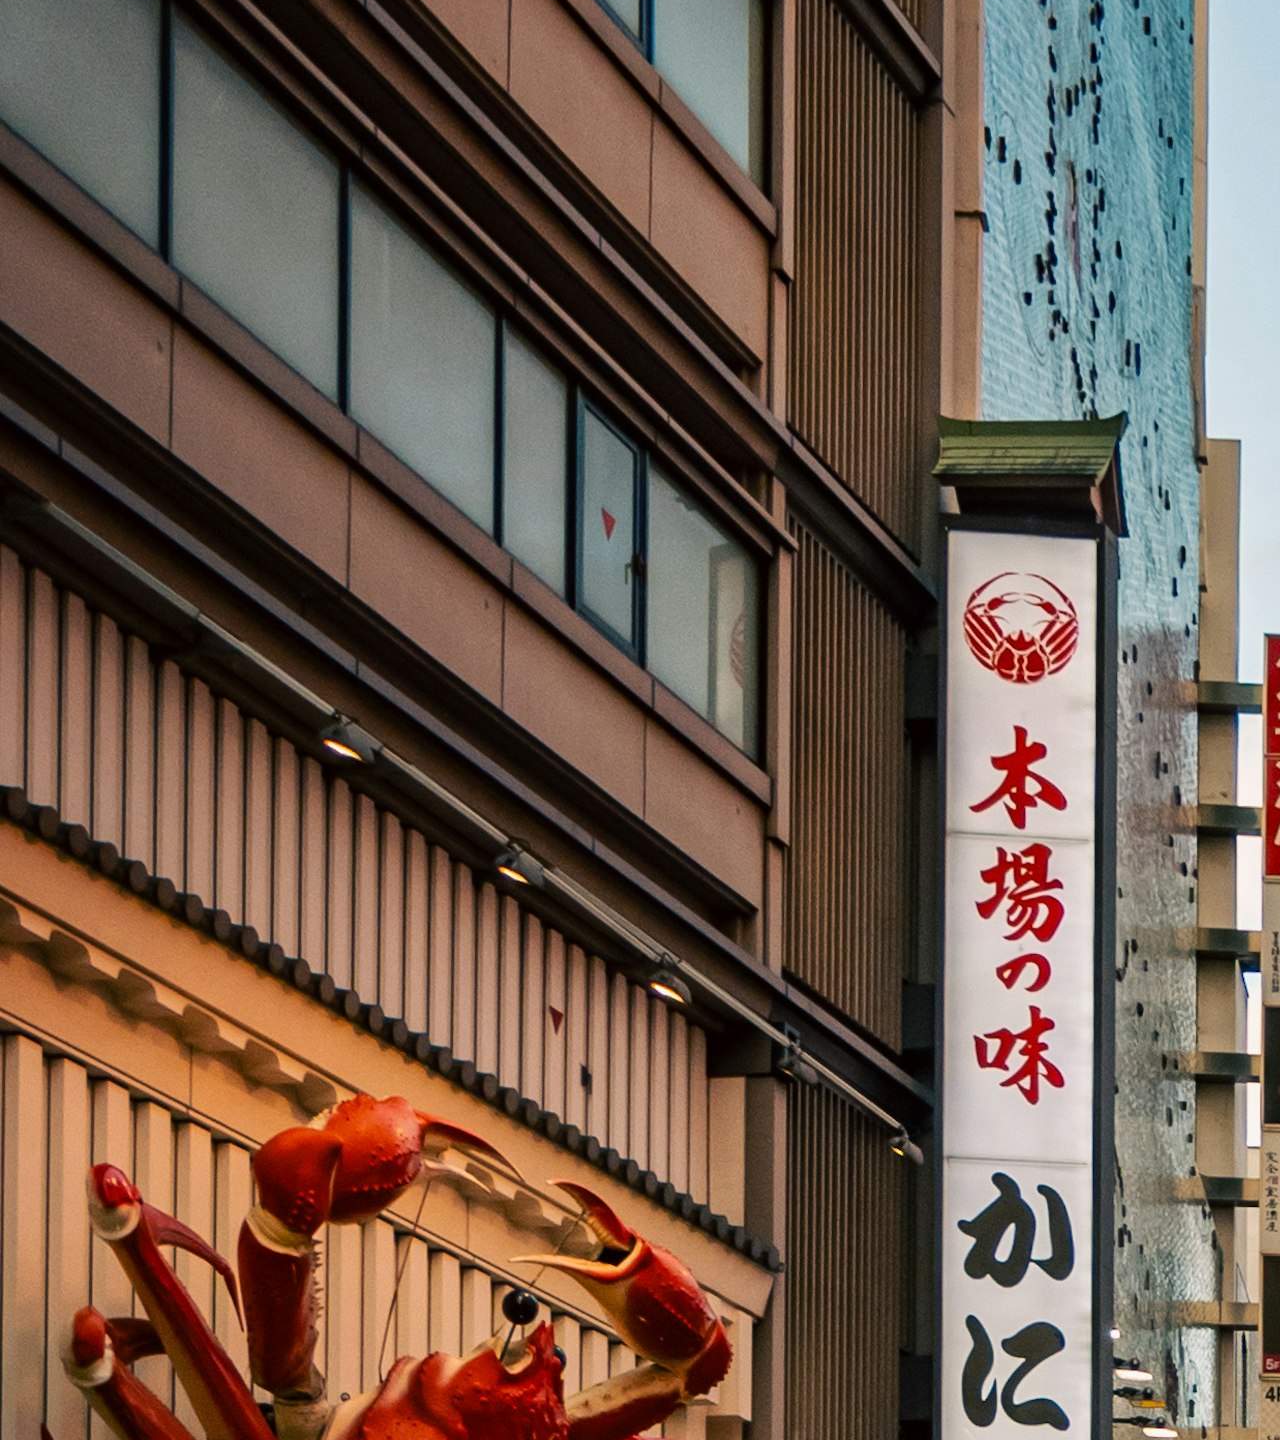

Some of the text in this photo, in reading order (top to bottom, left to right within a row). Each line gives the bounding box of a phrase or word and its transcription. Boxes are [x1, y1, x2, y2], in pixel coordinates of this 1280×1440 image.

[969, 725, 1068, 1107] 本場の味
[1265, 1357, 1280, 1371] 5F
